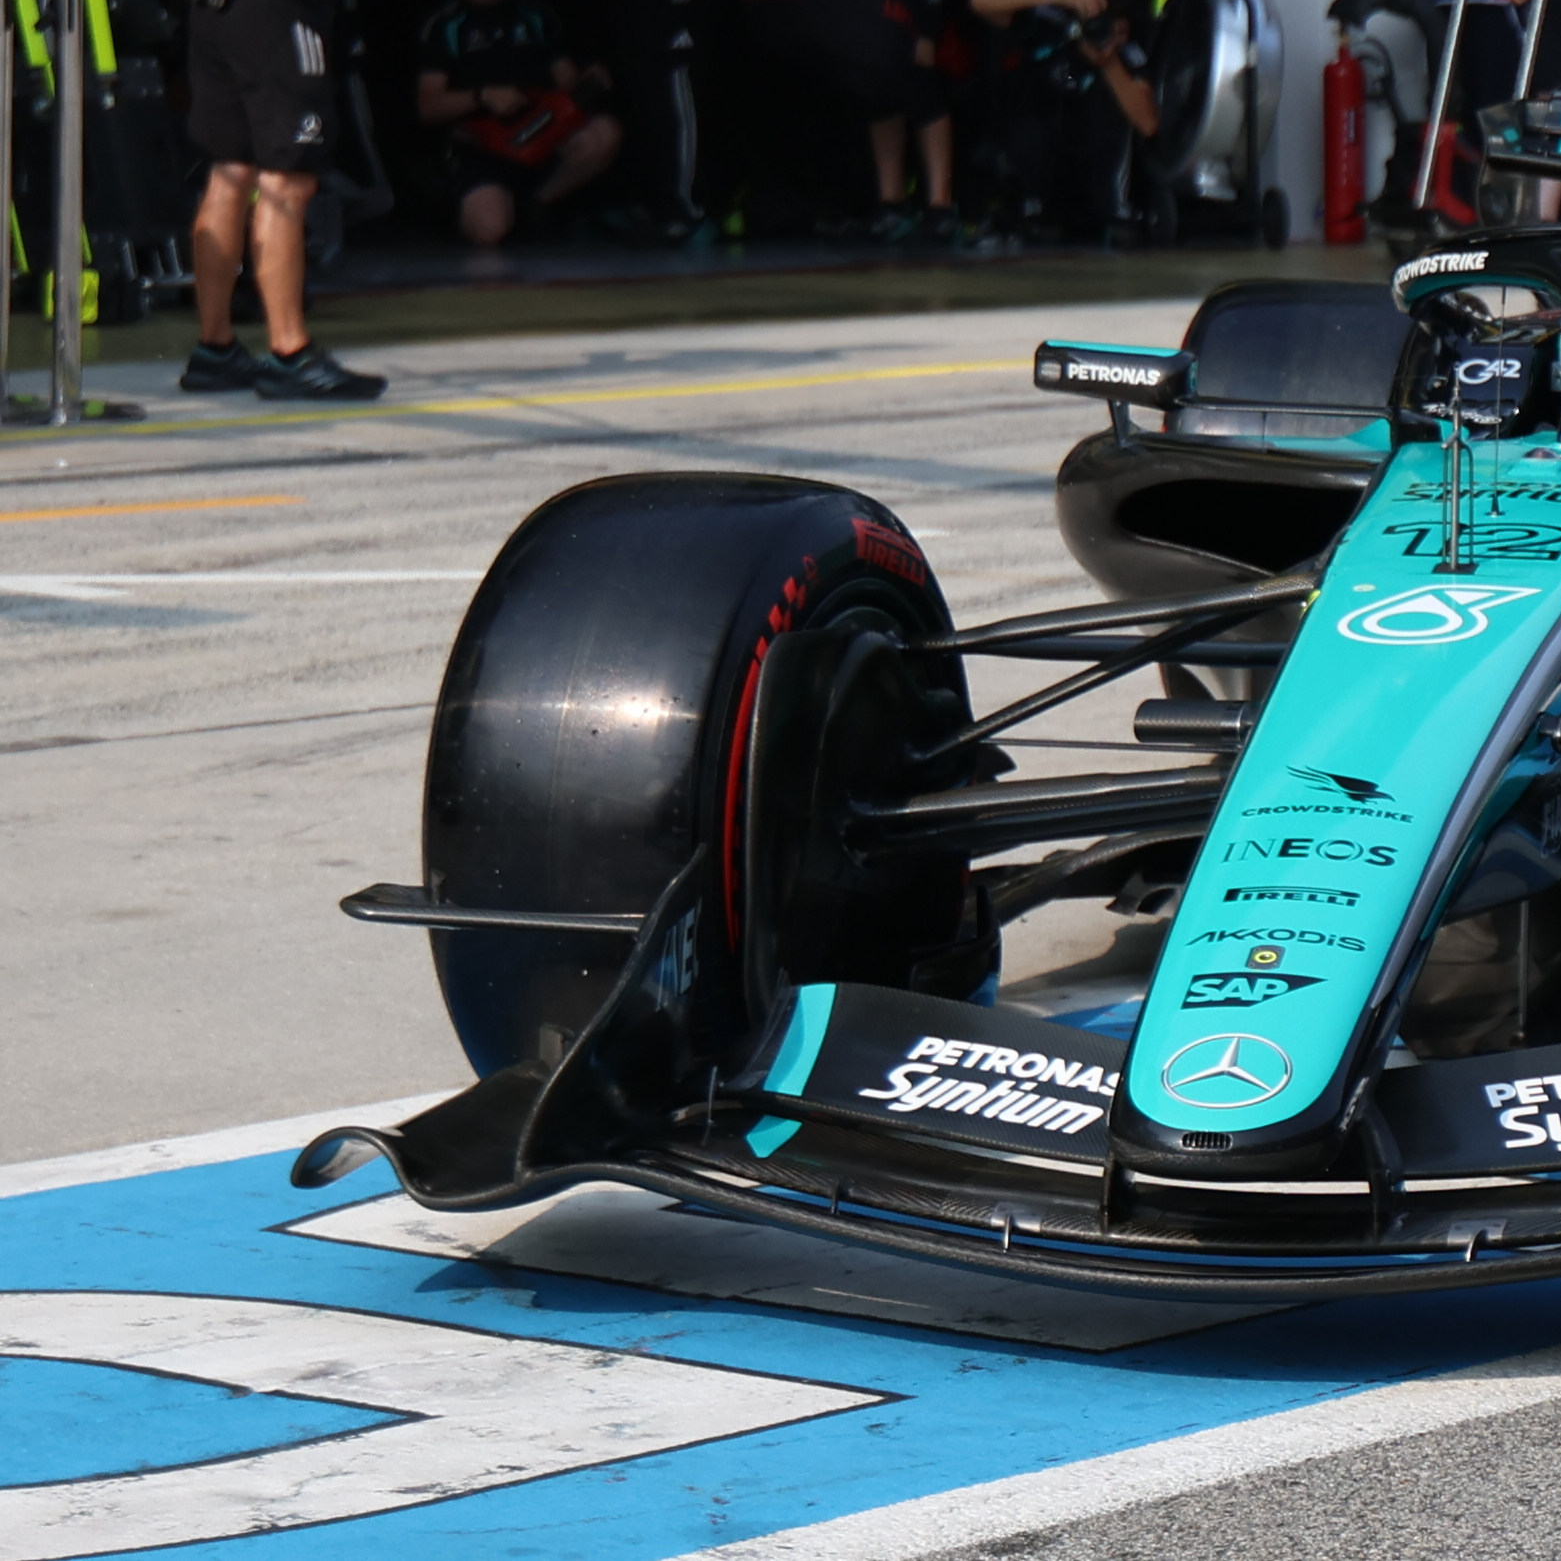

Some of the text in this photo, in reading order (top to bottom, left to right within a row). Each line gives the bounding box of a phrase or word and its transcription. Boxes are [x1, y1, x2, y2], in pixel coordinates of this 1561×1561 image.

[1392, 250, 1490, 288] CROWDSTRIKE
[1067, 361, 1162, 387] PETRONAS
[1458, 358, 1522, 385] G42
[852, 518, 927, 587] PIRELLI
[1241, 804, 1414, 824] CROWDSTRIKE
[1220, 838, 1399, 867] INEOS
[1223, 885, 1361, 908] PIRELLI
[1186, 977, 1290, 1003] SAP
[907, 1035, 1120, 1096] PETRONAS
[858, 1062, 1104, 1135] Syntium
